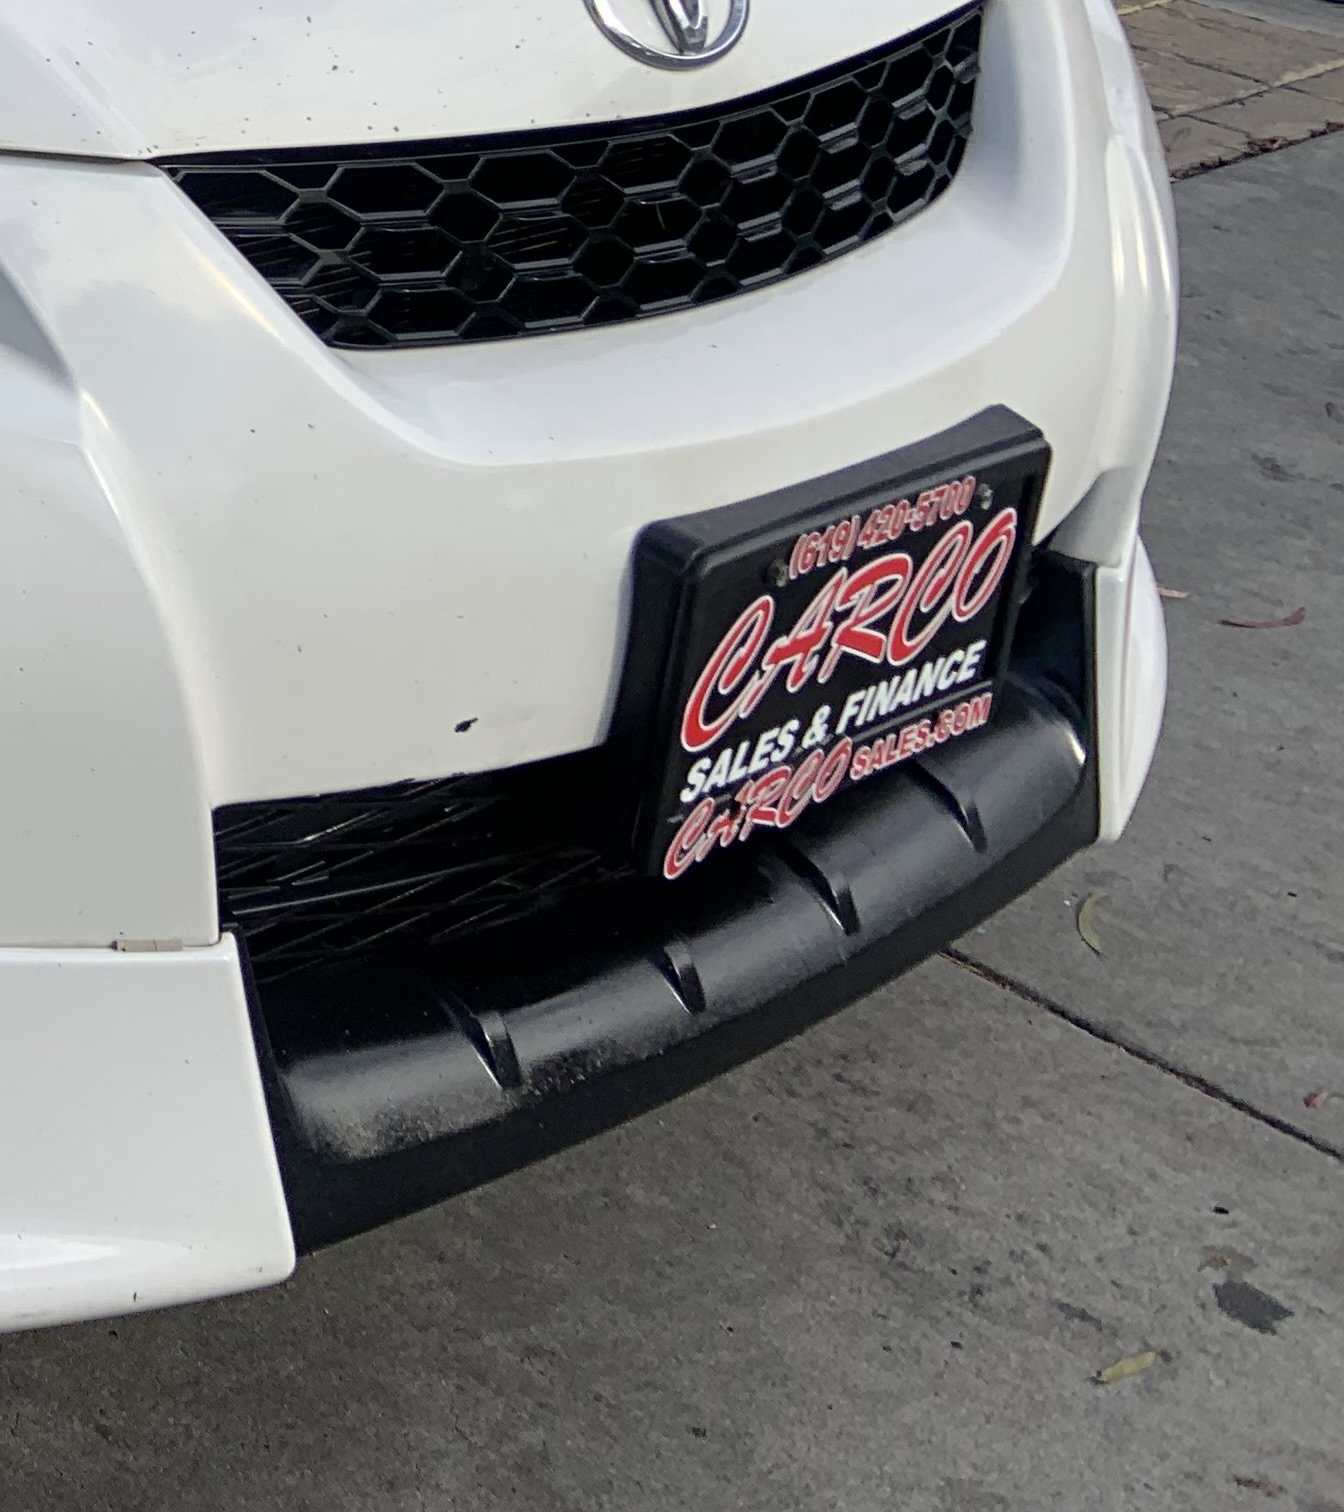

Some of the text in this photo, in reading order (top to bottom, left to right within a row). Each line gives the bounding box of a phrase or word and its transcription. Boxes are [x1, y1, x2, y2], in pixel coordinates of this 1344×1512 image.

[788, 476, 976, 580] (619) 420-5700
[681, 508, 1017, 752] CARCO
[680, 639, 987, 803] SALES & FINANCE
[664, 736, 853, 880] CARCO
